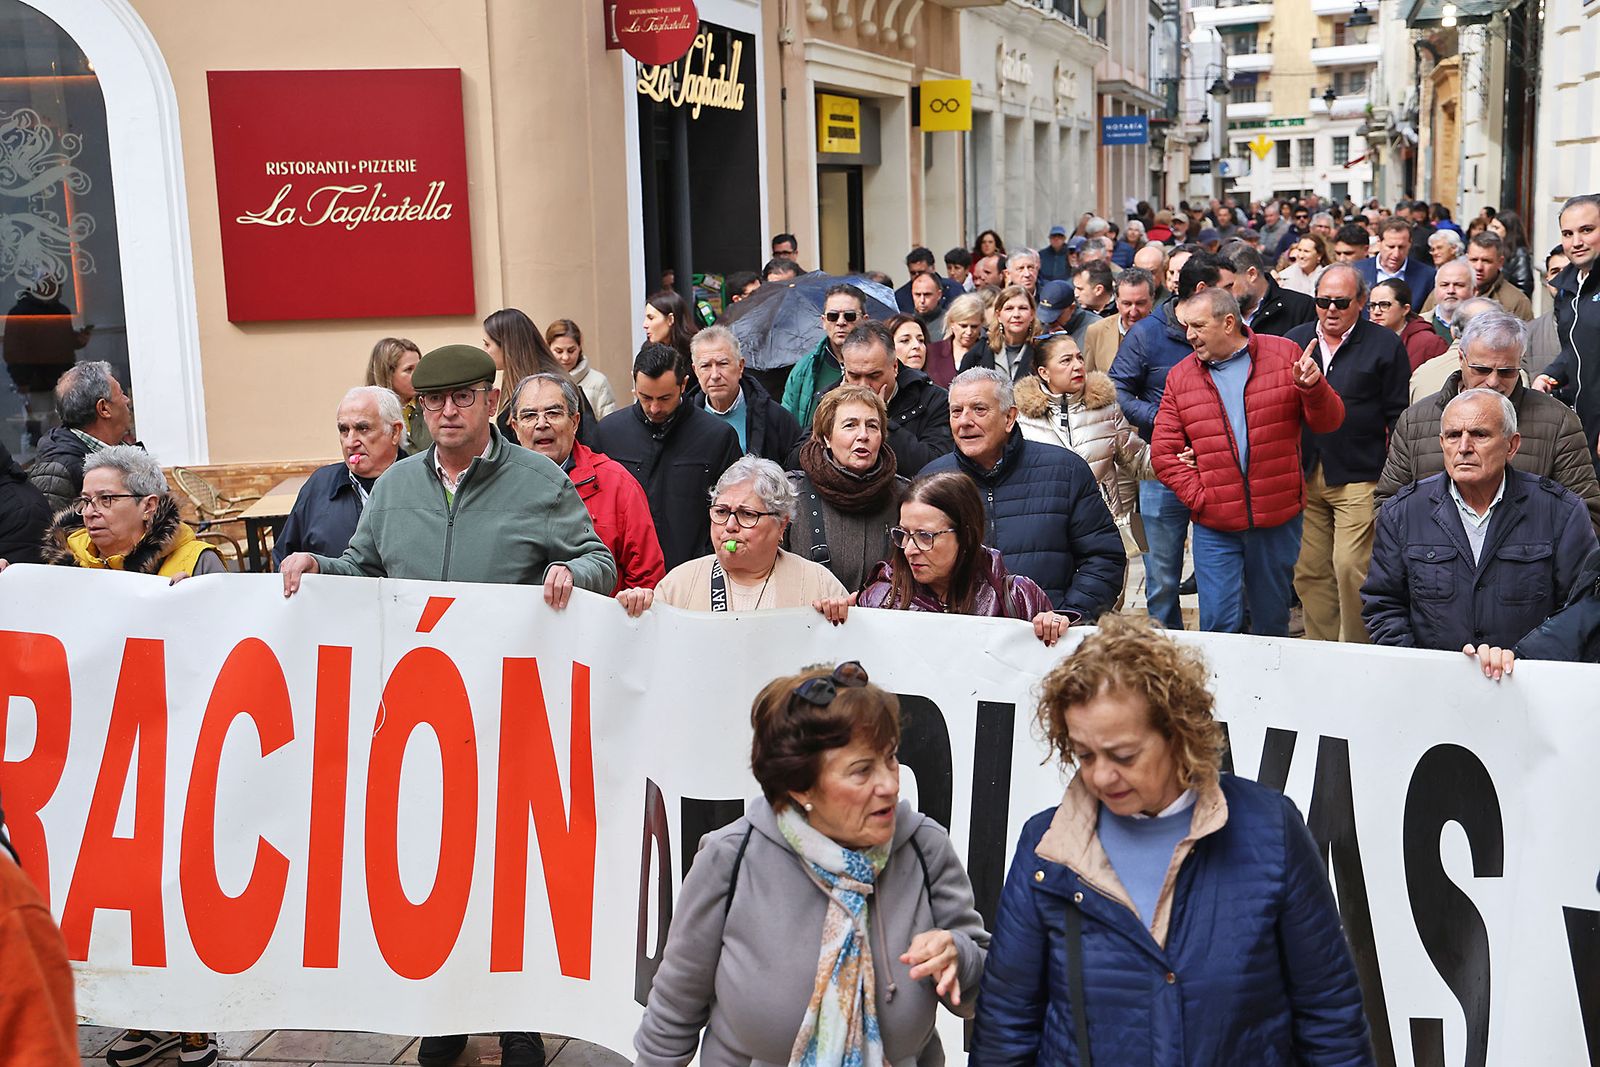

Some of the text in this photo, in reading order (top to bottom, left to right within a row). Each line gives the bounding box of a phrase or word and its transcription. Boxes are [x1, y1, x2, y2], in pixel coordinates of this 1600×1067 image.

[621, 14, 691, 34] La Tagliatella
[670, 32, 745, 120] Tagliatella
[265, 159, 417, 175] RISTORANTI PIZZERIE
[236, 180, 454, 231] La Tagliatella
[0, 596, 597, 981] RACIÓN
[633, 776, 746, 1008] D
